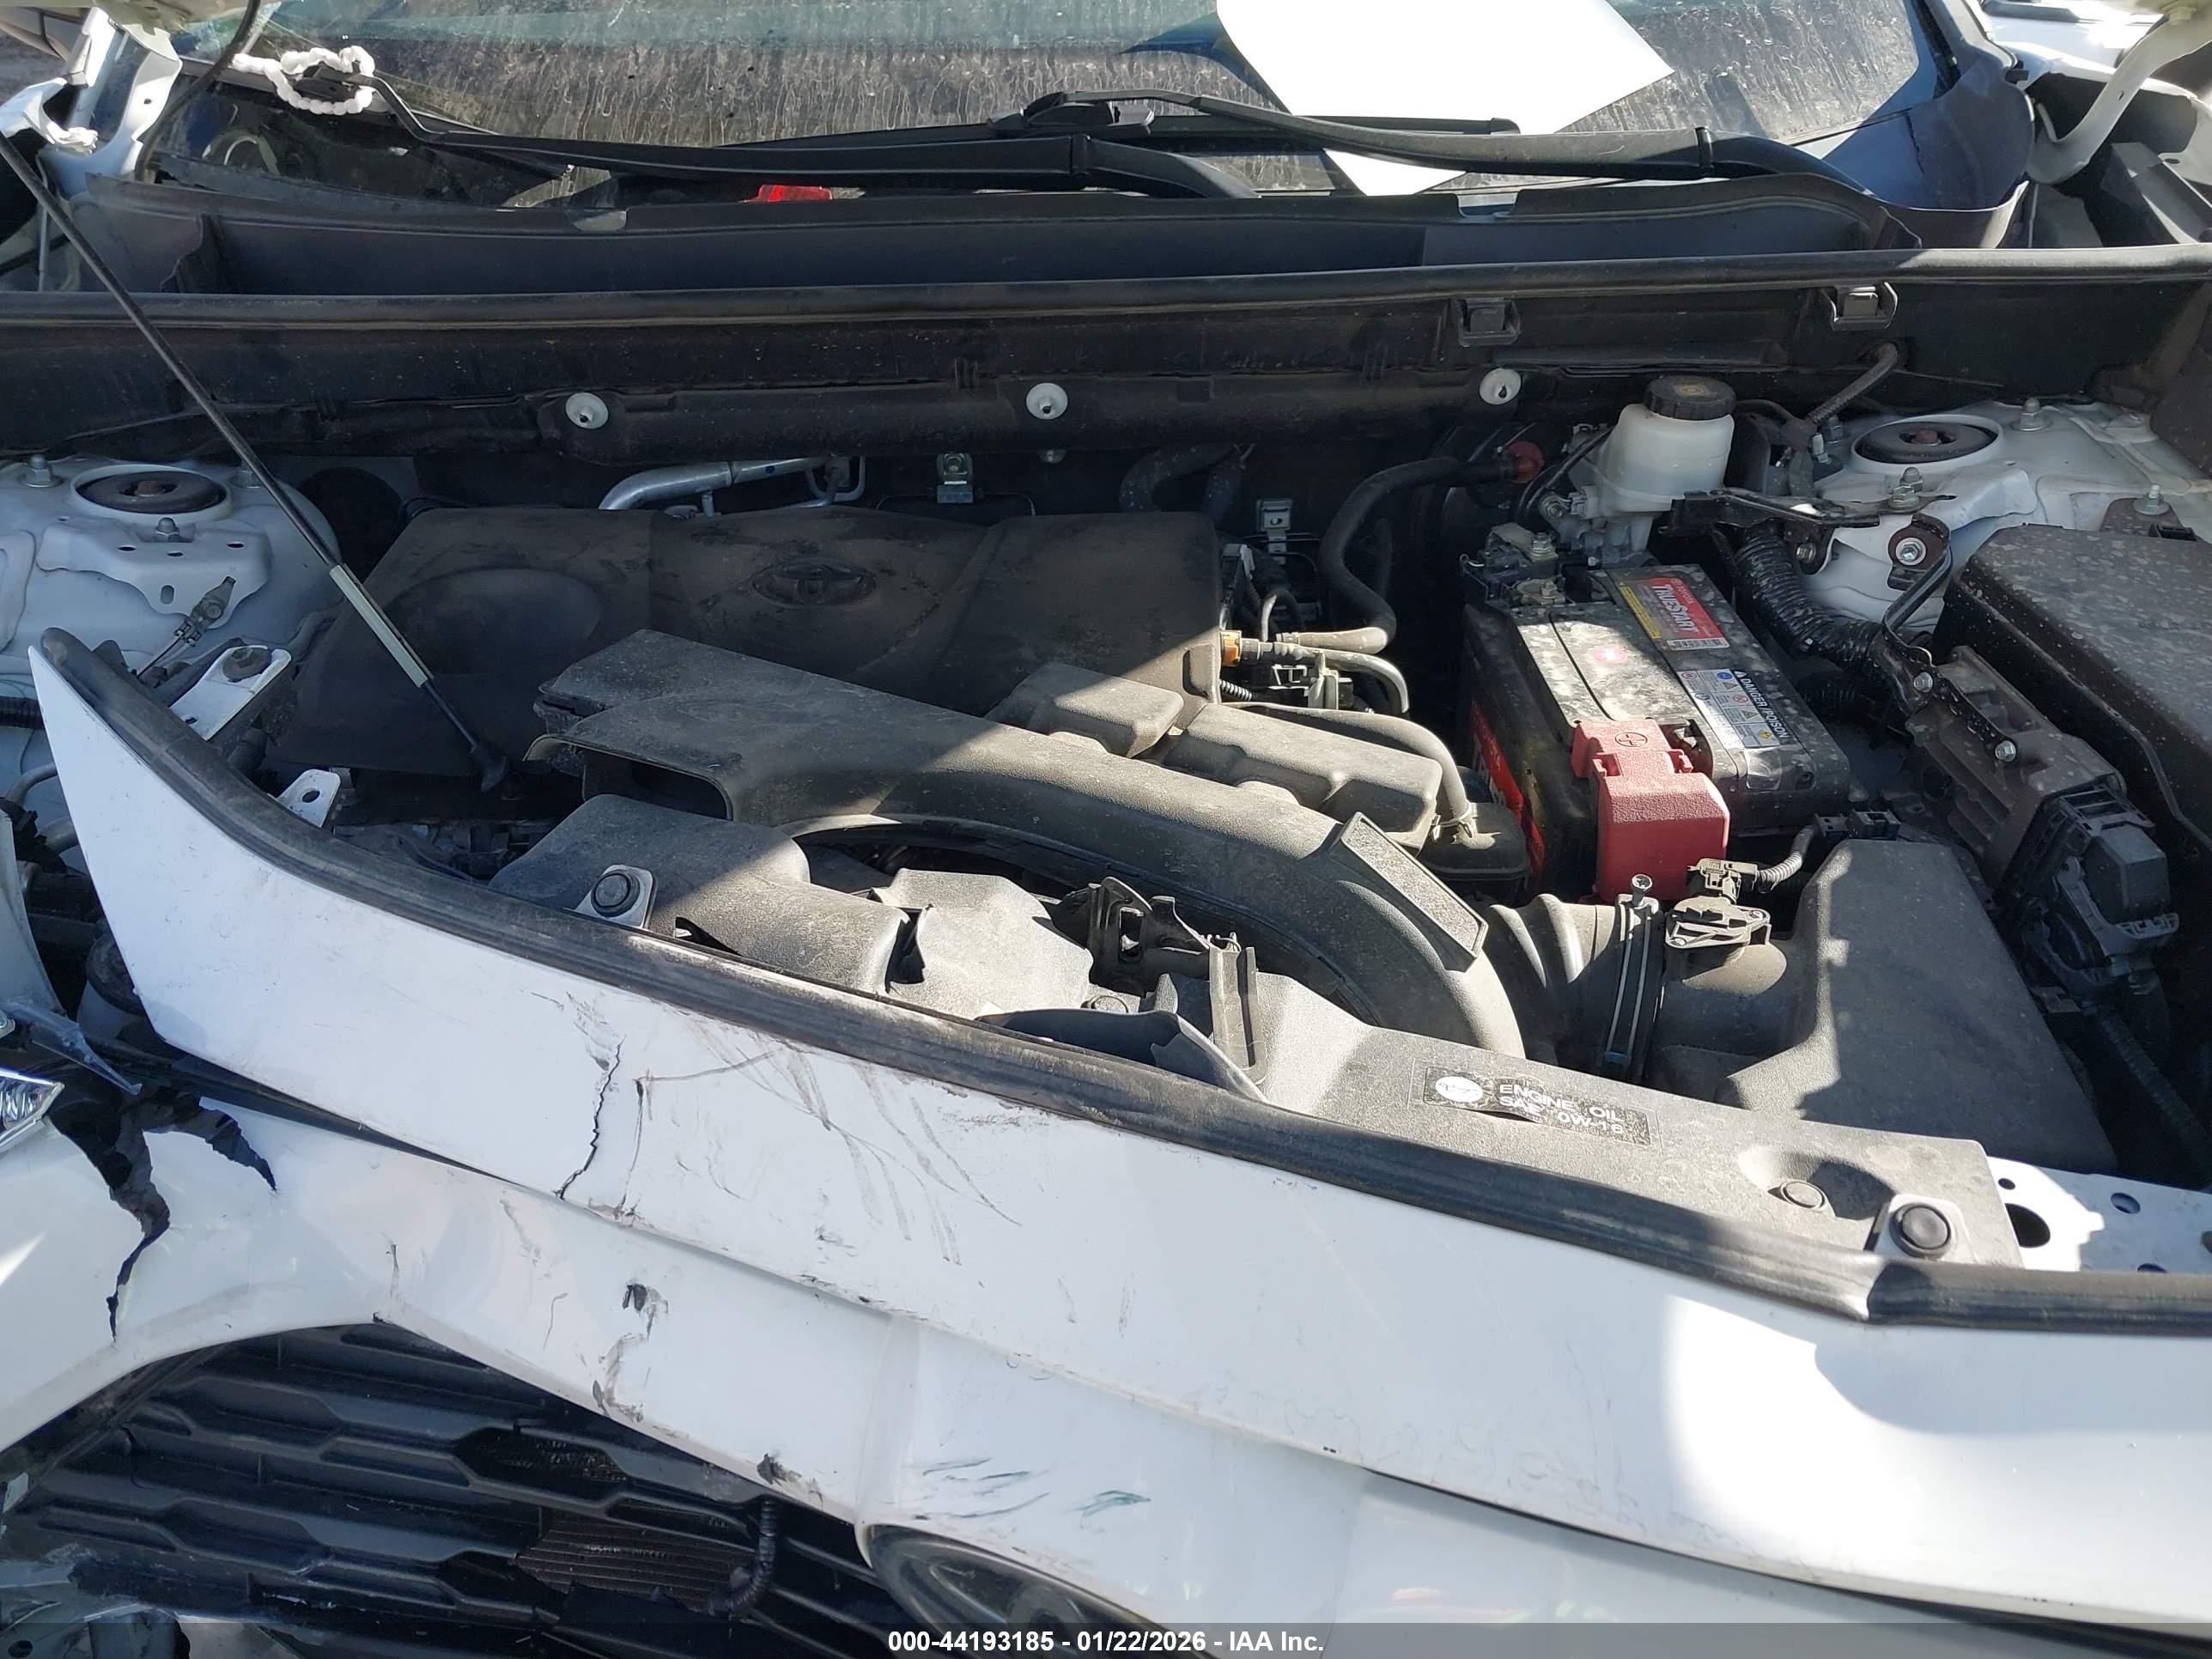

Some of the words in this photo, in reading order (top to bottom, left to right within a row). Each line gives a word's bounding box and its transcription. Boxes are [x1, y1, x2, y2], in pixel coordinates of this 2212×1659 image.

[1676, 585, 1695, 605] TOYOTA
[1740, 678, 1768, 708] DANGER
[1763, 710, 1790, 738] POISON
[1499, 1097, 1540, 1115] SAE
[1559, 1112, 1624, 1134] 0W-16
[1500, 1085, 1575, 1110] ENGINE
[1589, 1107, 1626, 1122] OIL
